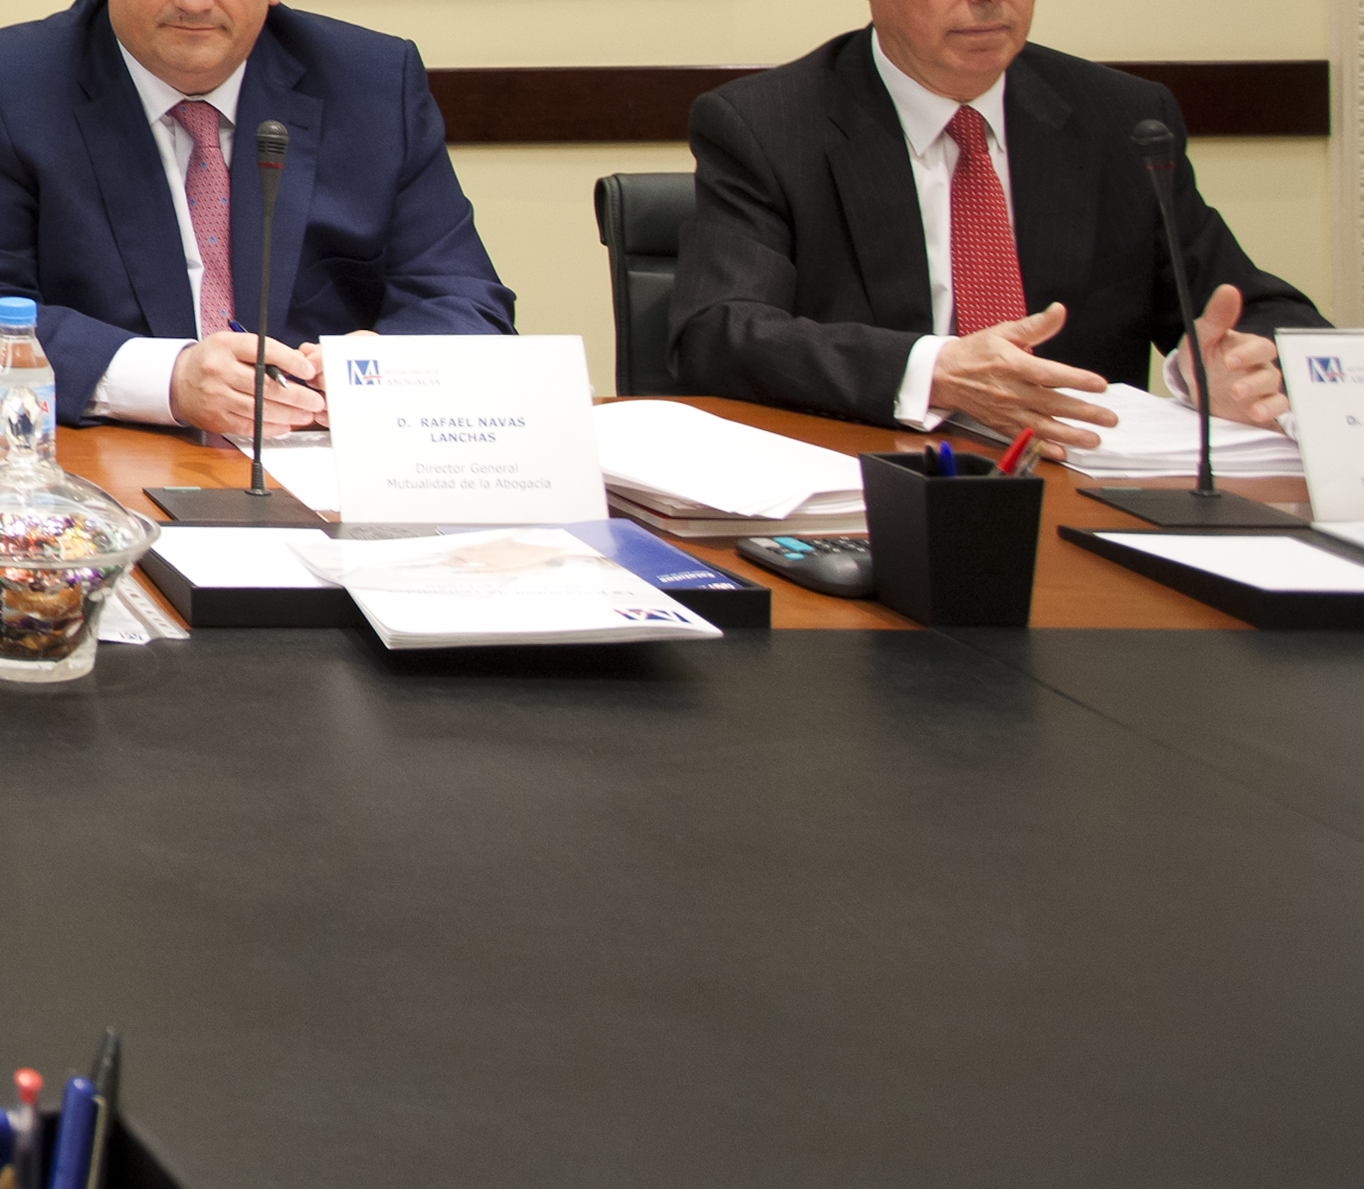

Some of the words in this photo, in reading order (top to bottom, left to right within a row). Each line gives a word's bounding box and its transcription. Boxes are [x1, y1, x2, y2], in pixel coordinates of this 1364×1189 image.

[397, 417, 412, 428] D.
[420, 416, 473, 428] RAFAEL
[478, 416, 526, 428] NAVAS
[430, 432, 497, 443] LANCHAS
[416, 462, 466, 474] Director
[470, 462, 519, 474] General
[387, 478, 456, 489] Mutualidad
[460, 478, 475, 489] de
[479, 478, 491, 489] la
[495, 476, 552, 491] Abogacía
